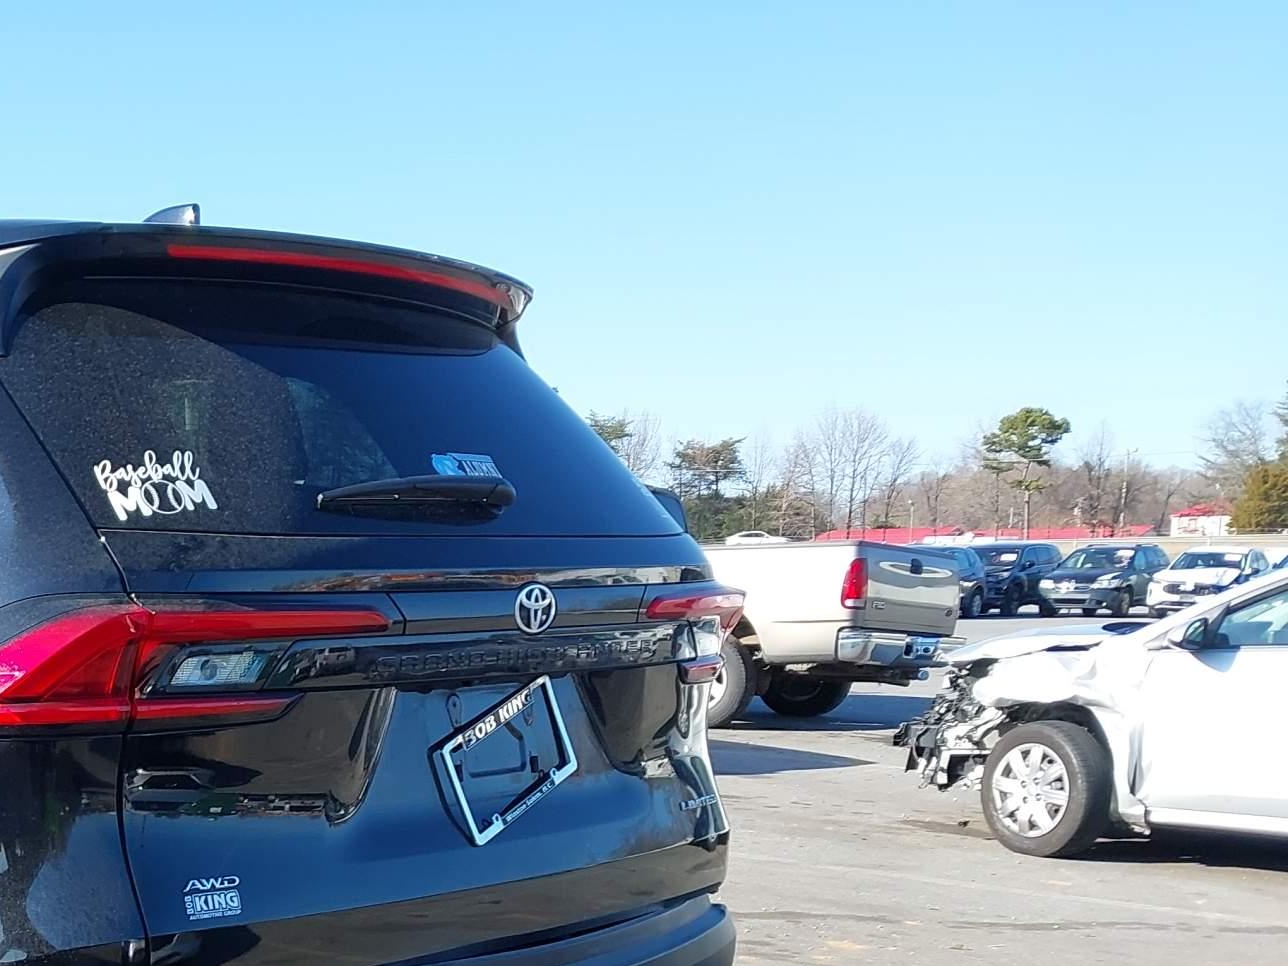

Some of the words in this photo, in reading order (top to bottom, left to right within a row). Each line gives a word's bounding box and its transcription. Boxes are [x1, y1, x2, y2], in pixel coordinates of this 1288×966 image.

[93, 449, 200, 491] Baseball
[106, 479, 218, 521] MOM
[499, 688, 533, 723] KING
[183, 876, 240, 892] AWD
[184, 895, 194, 915] BOB
[194, 891, 240, 912] KING
